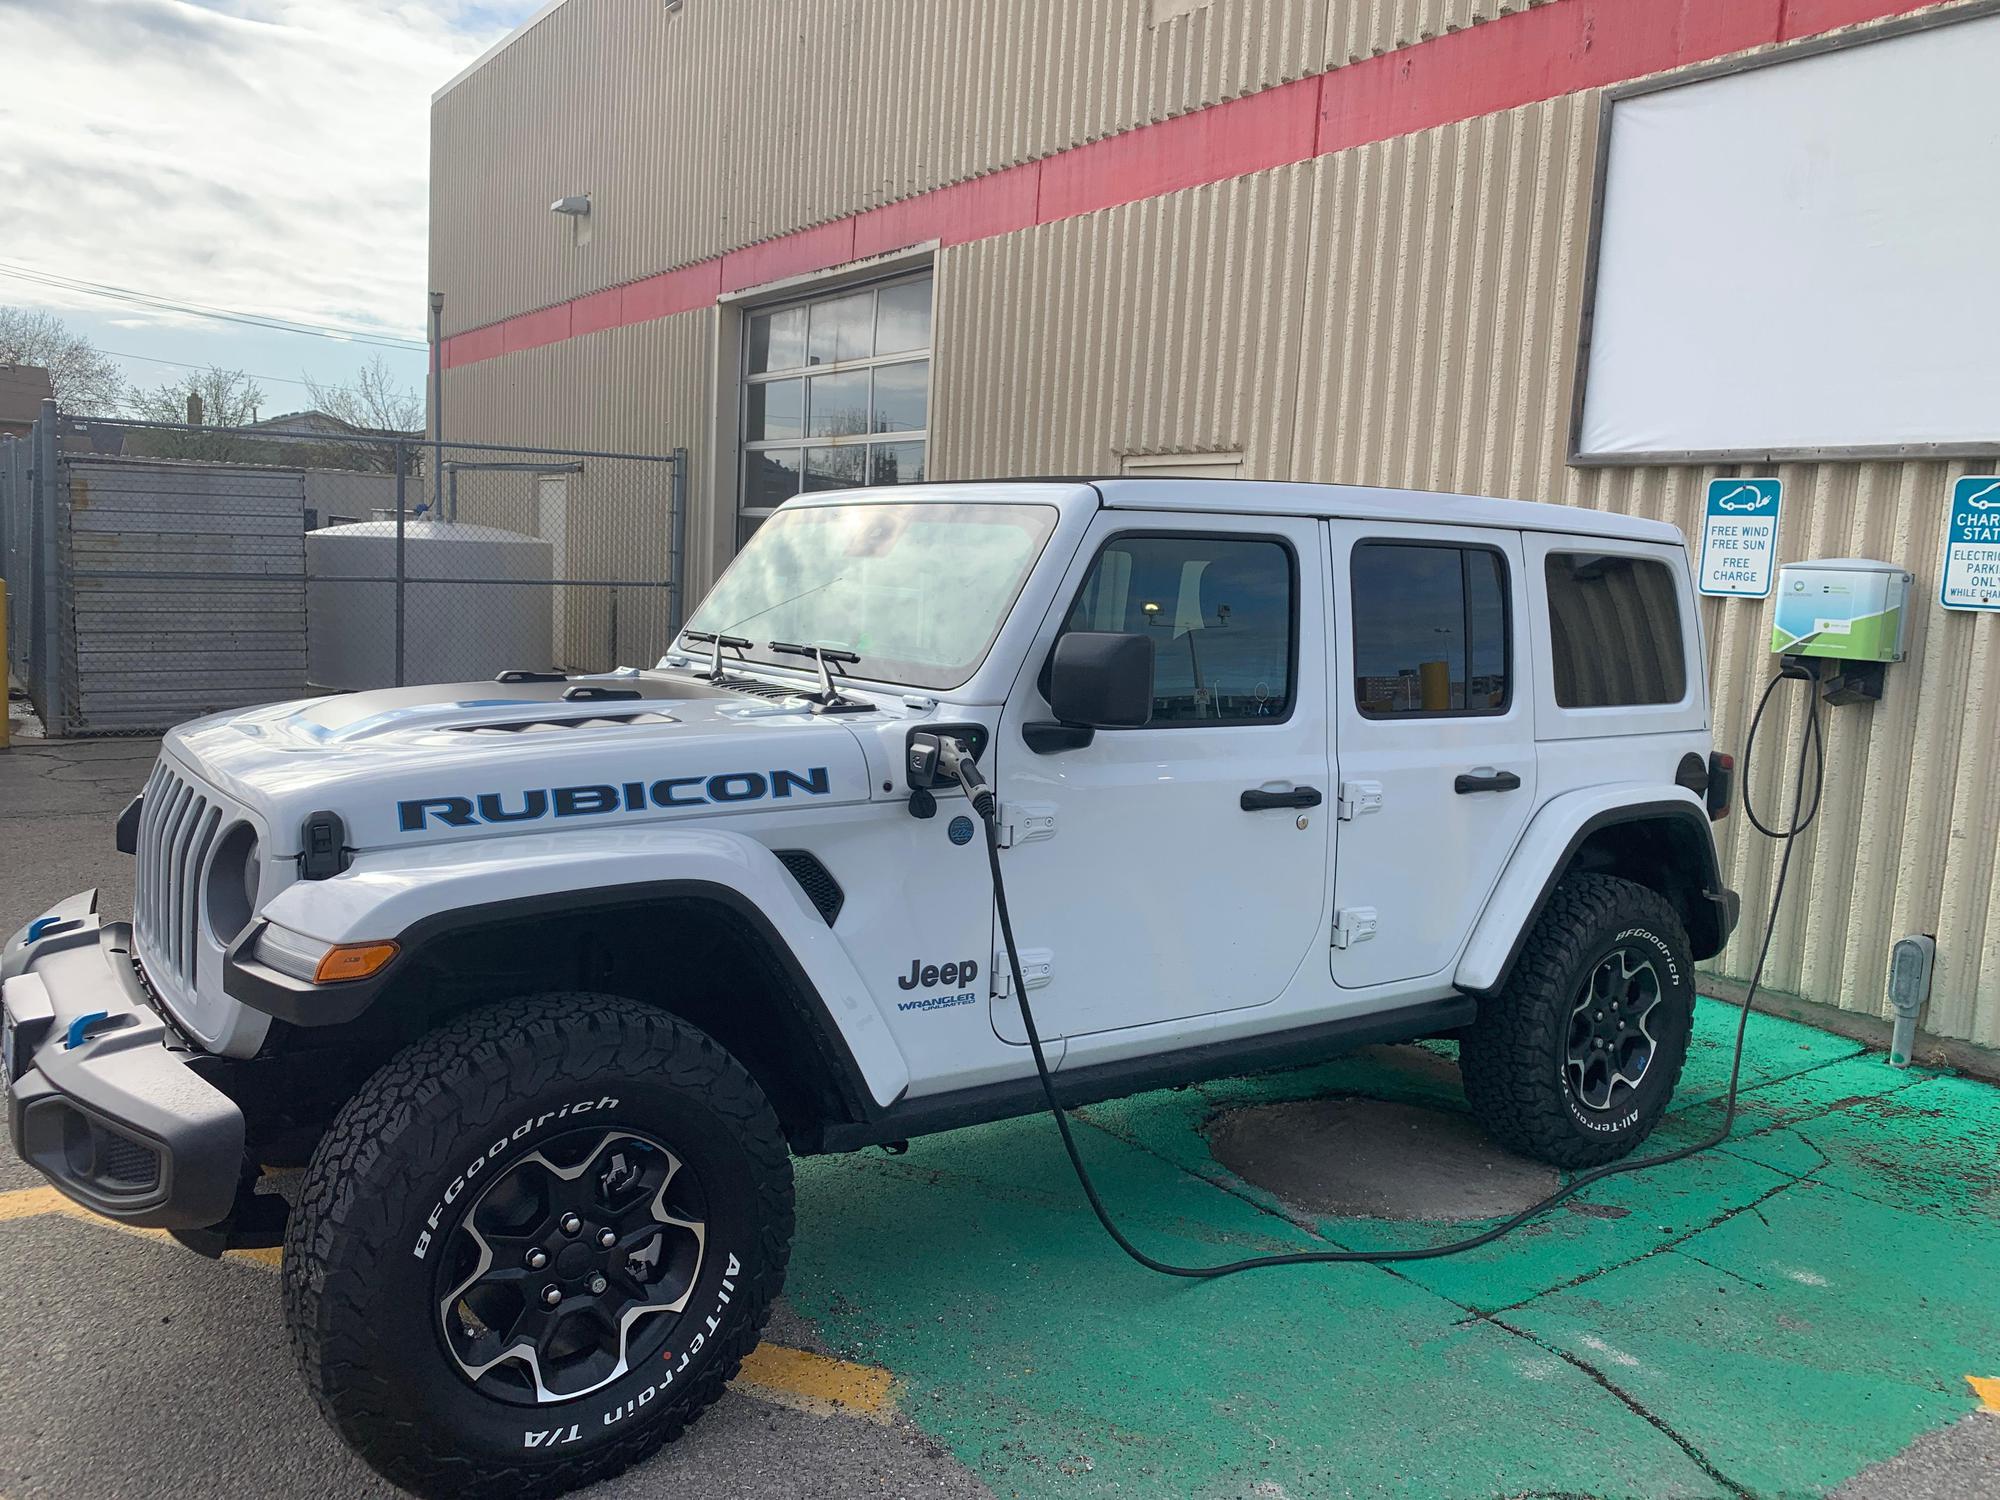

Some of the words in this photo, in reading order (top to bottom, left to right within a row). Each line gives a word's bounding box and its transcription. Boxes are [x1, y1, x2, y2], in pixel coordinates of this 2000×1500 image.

[1711, 526, 1738, 536] FREE
[1742, 526, 1769, 537] WIND
[1712, 539, 1738, 549] FREE
[1743, 540, 1765, 550] SUN
[1723, 557, 1750, 568] FREE
[1967, 563, 2000, 574] PARKI
[1713, 570, 1757, 582] CHARGE
[1950, 588, 1976, 597] WHILE
[396, 766, 831, 832] RUBICON
[1615, 928, 1680, 986] BFGoodrich
[898, 959, 978, 990] Jeep
[897, 992, 976, 1011] WRANGLER
[922, 999, 976, 1011] UNLIMITED
[413, 1096, 620, 1260] BFGoodrich
[603, 1252, 741, 1426] All-Terrain
[523, 1423, 584, 1449] T/A
